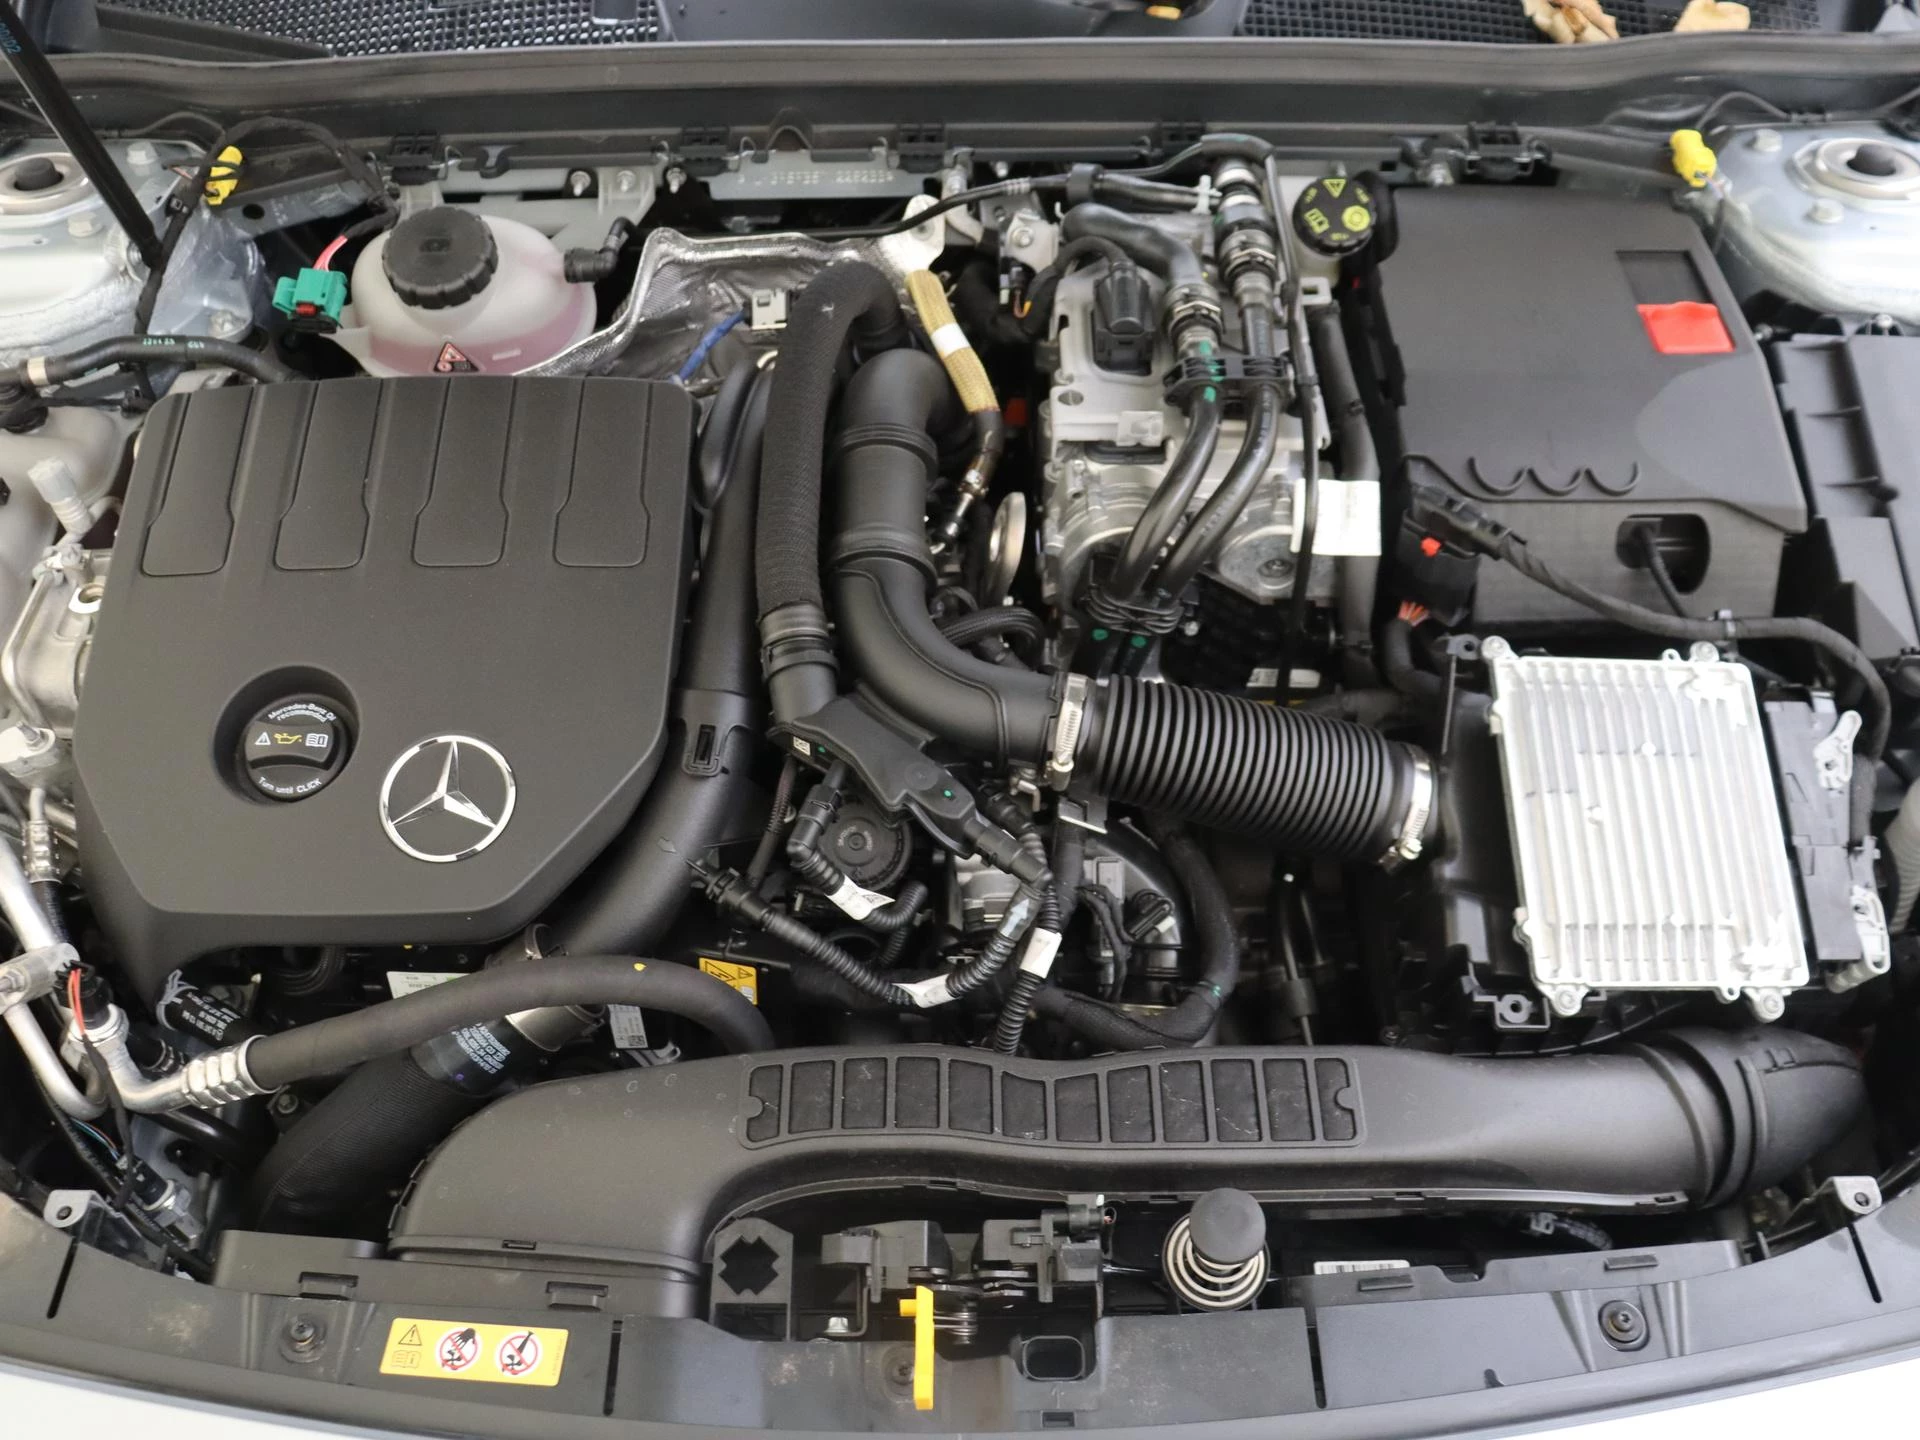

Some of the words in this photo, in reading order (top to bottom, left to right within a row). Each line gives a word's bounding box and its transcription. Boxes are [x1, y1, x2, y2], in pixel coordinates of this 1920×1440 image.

[277, 709, 327, 722] recommended
[259, 776, 275, 791] Turn
[276, 786, 294, 794] until
[296, 777, 322, 793] CLICK
